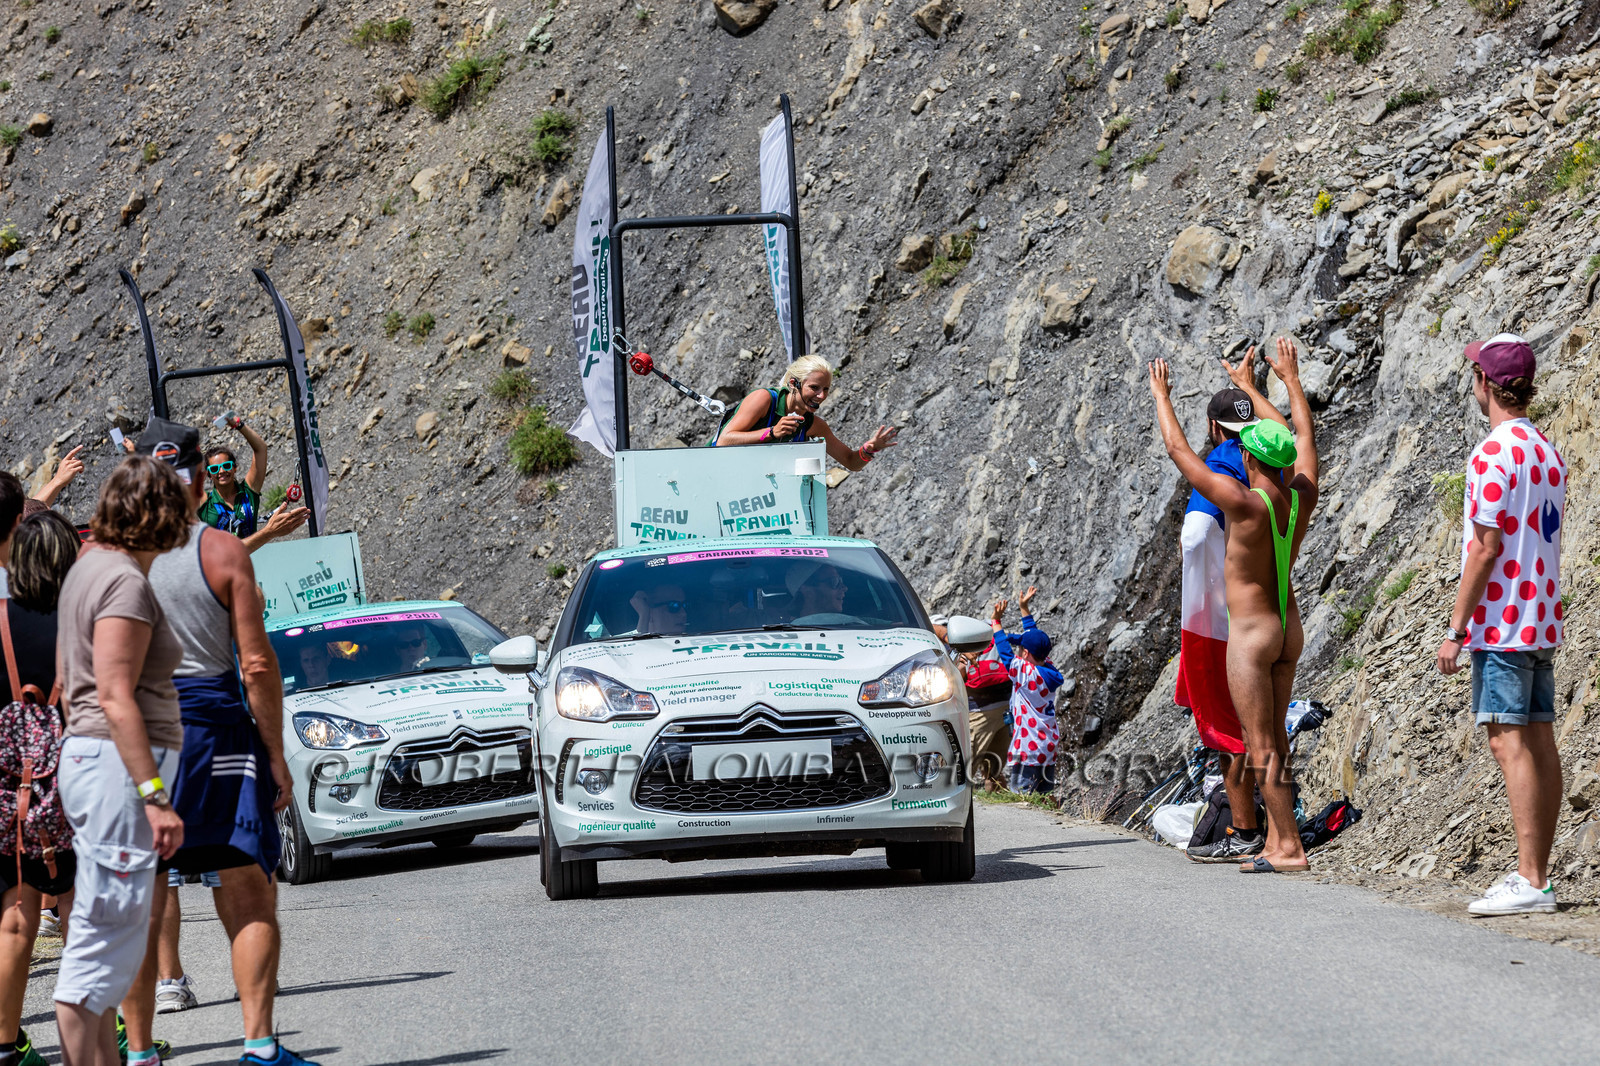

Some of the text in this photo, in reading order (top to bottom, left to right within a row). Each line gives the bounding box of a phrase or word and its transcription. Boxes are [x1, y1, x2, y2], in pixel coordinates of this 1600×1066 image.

[572, 264, 589, 361] BEAU
[729, 492, 776, 517] BEAU
[640, 507, 689, 525] BEAU
[723, 510, 799, 533] TRAVAIL!
[697, 550, 757, 558] CARAVANE
[299, 567, 334, 591] BEAU
[296, 578, 352, 602] TRAVAIL!
[311, 596, 344, 608] beautravail.org
[672, 642, 845, 655] TRAVAIL!
[646, 680, 719, 691] Ingénieur qualité
[768, 681, 833, 691] Logistique
[820, 677, 860, 685] Outilleur
[378, 679, 503, 697] TRAVAIL!
[669, 688, 696, 696] Ajusteur
[661, 693, 737, 706] Yield manager
[466, 705, 513, 715] Logistique
[868, 709, 932, 719] Développeur web
[391, 720, 447, 735] Yield manager
[881, 733, 928, 744] Industrie
[584, 744, 632, 758] Logistique
[335, 764, 375, 782] Logistique
[577, 801, 615, 812] Services
[891, 798, 948, 810] Formation
[336, 810, 369, 825] Services
[419, 808, 458, 822] Construction
[816, 814, 855, 824] Infirmier
[342, 819, 404, 838] Ingénieur qualité
[578, 819, 656, 834] Ingénieur qualité
[677, 819, 731, 828] Construction
